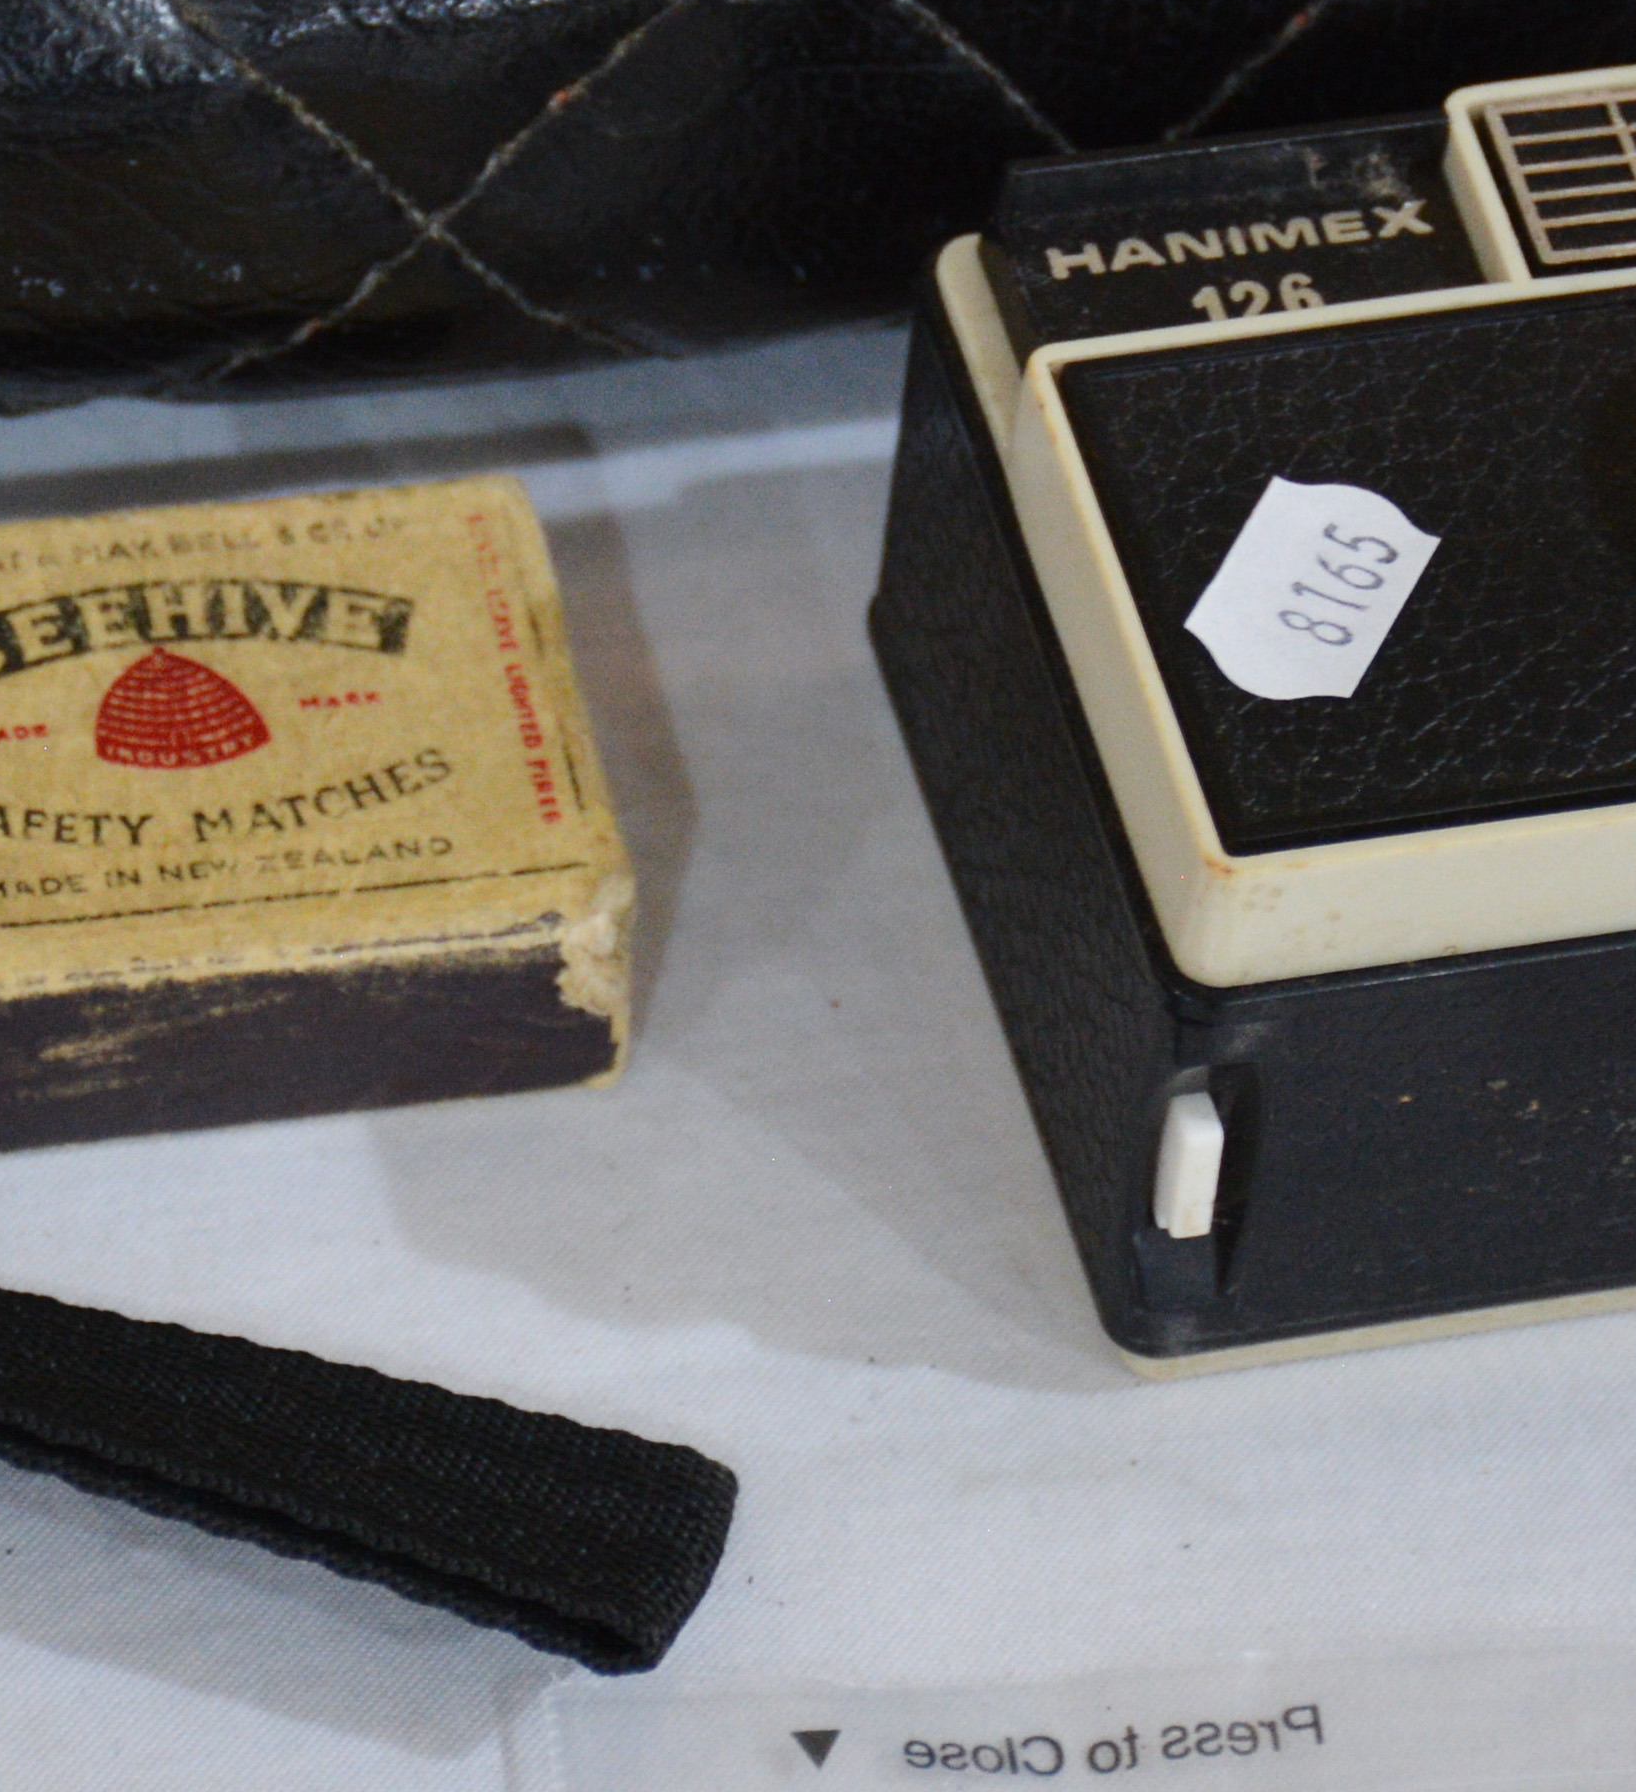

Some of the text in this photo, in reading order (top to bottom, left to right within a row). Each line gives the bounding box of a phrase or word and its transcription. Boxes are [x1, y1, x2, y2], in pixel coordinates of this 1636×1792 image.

[1045, 199, 1435, 280] HANIMEX
[1191, 271, 1324, 323] 126
[1278, 522, 1398, 646] 8165
[299, 691, 381, 709] MARK
[105, 734, 256, 767] INDUSTRY
[193, 746, 452, 843] MATCHES
[105, 868, 142, 888] IN
